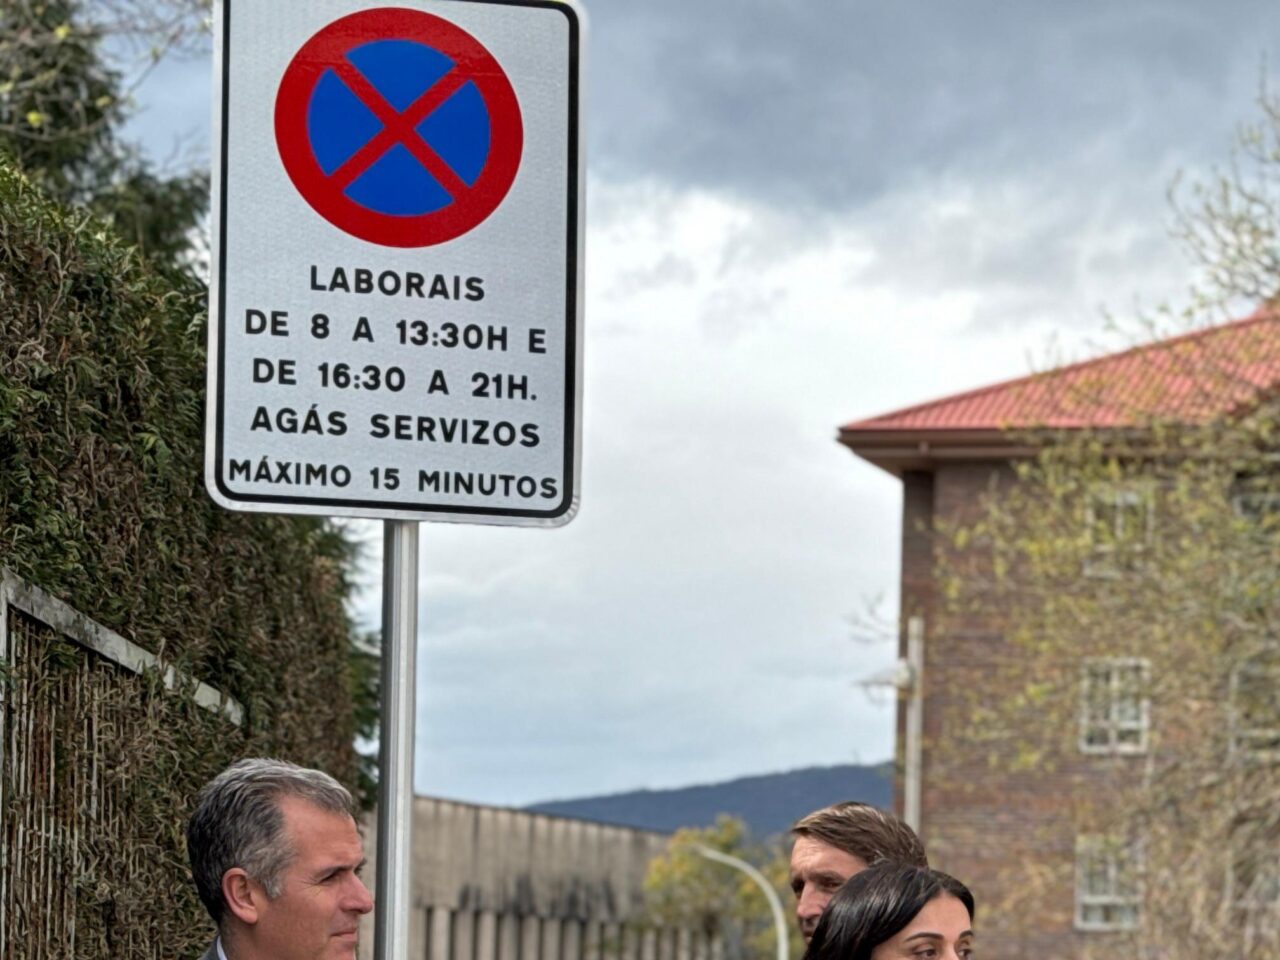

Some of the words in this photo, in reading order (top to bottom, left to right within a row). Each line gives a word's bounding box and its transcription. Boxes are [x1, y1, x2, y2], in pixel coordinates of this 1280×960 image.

[310, 265, 485, 302] LABORAIS
[245, 309, 289, 337] DE
[311, 313, 330, 339] 8
[352, 316, 374, 343] A
[396, 319, 508, 352] 13:30H
[528, 328, 547, 354] E
[253, 357, 297, 386] DE
[318, 362, 406, 393] 16:30
[427, 369, 449, 395] A
[471, 371, 538, 401] 21H.
[250, 403, 348, 436] AGÁS
[370, 413, 540, 448] SERVIZOS
[229, 455, 352, 488] MÁXIMO
[370, 467, 400, 491] 15
[418, 469, 558, 500] MINUTOS
